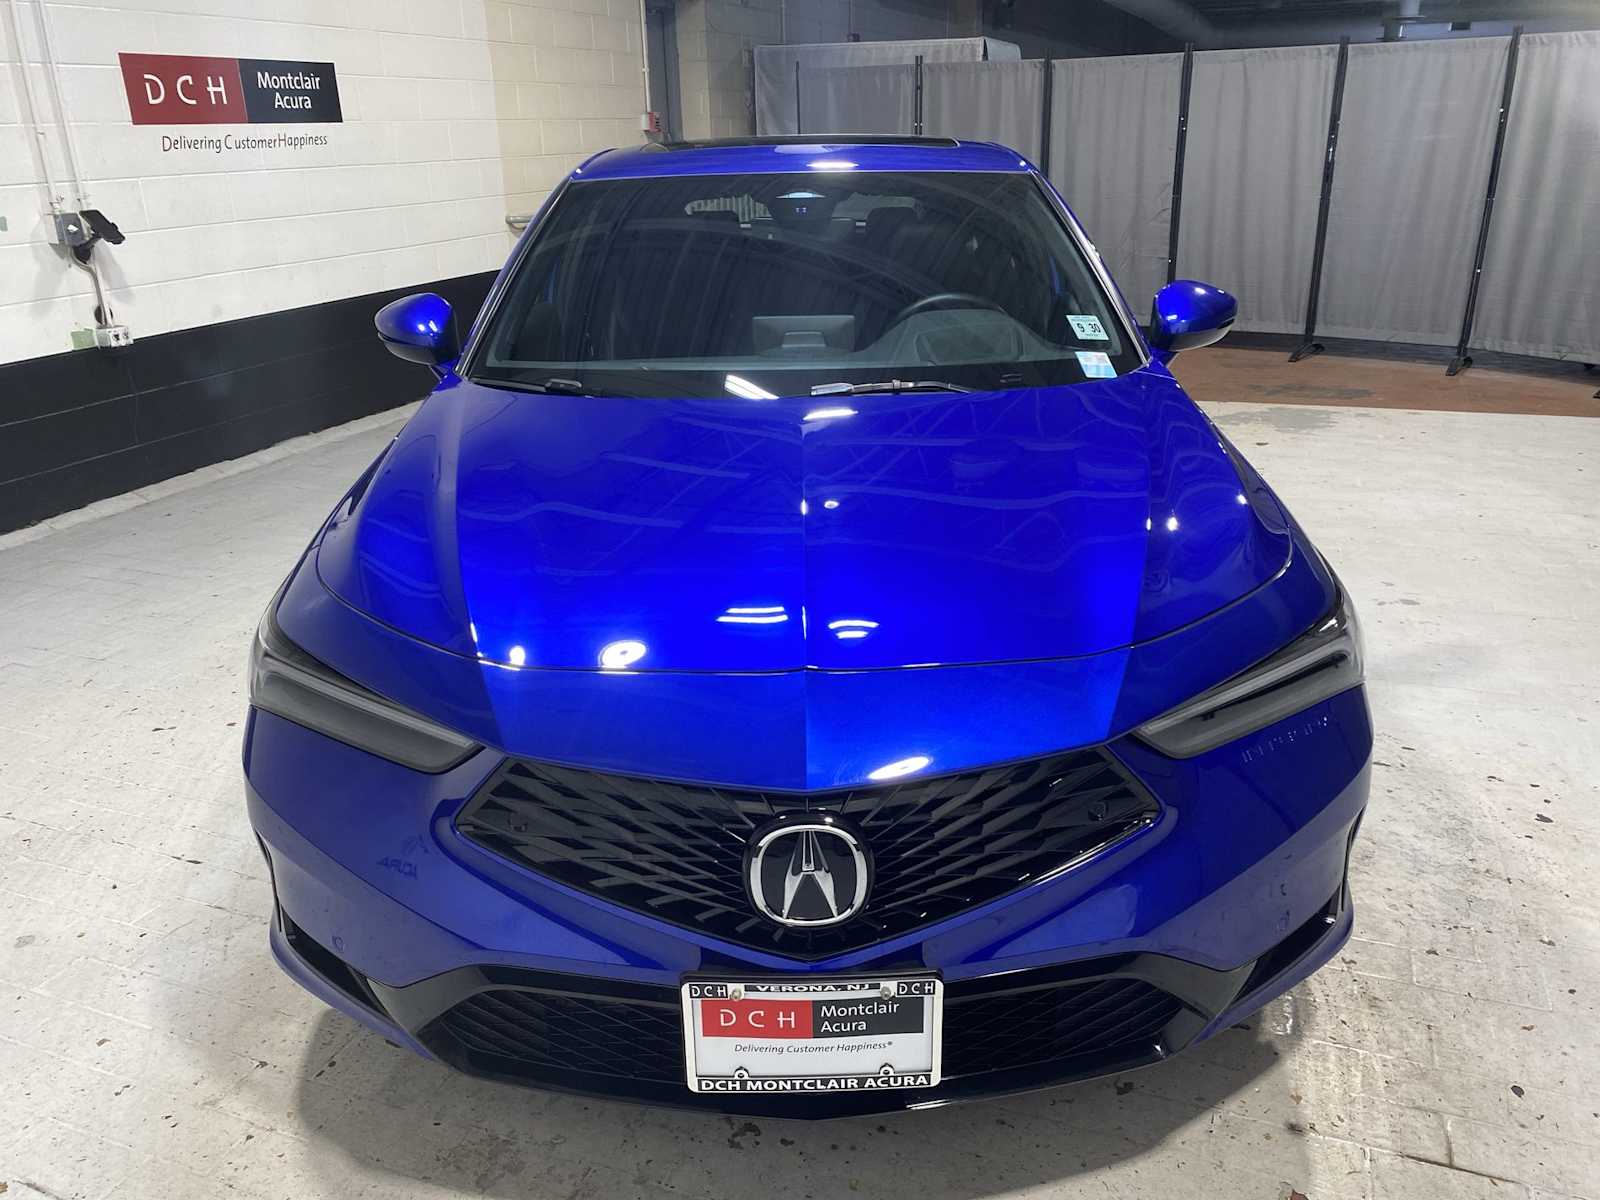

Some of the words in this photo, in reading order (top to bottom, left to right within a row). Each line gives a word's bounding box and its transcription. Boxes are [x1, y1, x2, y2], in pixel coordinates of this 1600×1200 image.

[257, 71, 321, 90] Montclair
[274, 92, 312, 109] Acura
[162, 135, 222, 153] Delivering
[690, 985, 727, 997] DCH
[847, 983, 870, 991] NJ
[899, 982, 935, 995] DCH
[820, 1001, 900, 1018] Montclair
[820, 1021, 868, 1034] Acura
[734, 1043, 785, 1055] Delivering
[786, 1044, 834, 1053] Customer
[701, 1080, 741, 1091] DCH
[746, 1078, 859, 1091] MONTCLAIR
[864, 1075, 929, 1088] ACURA
